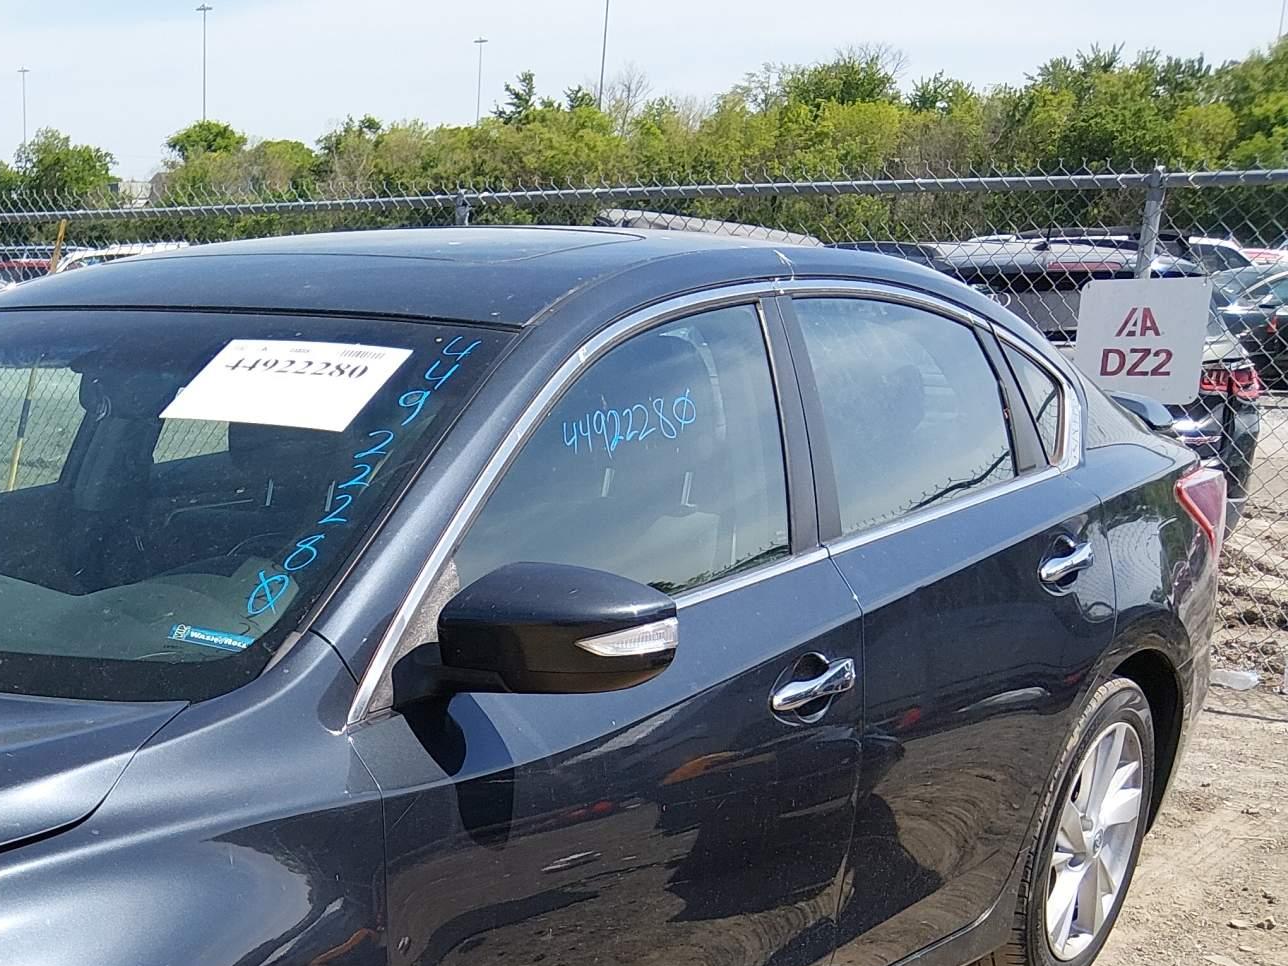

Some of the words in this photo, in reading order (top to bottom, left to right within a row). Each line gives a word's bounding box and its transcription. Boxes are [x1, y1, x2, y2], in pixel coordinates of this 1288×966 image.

[225, 357, 369, 379] 44922280
[1100, 348, 1173, 377] DZ2
[563, 388, 696, 459] 44922280
